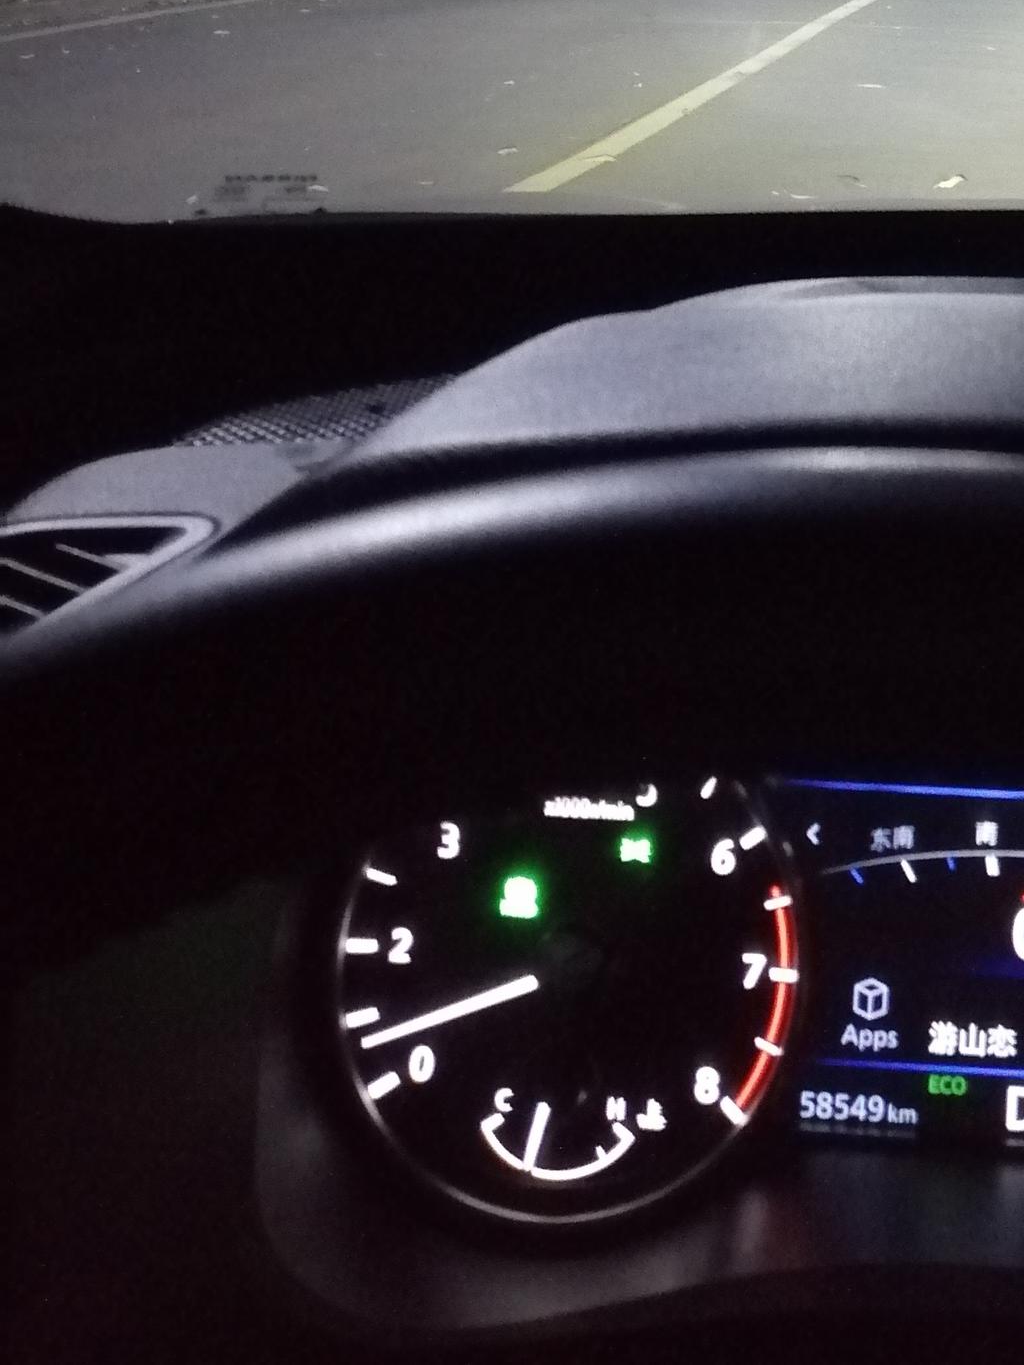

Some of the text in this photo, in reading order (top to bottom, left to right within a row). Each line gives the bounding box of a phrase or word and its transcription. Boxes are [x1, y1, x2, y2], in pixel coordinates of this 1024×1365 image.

[437, 821, 460, 859] 3
[711, 838, 736, 875] 6
[388, 927, 414, 964] 2
[742, 952, 768, 989] 7
[841, 1023, 898, 1052] Apps
[408, 1044, 435, 1083] 0
[694, 1066, 721, 1108] 8
[928, 1075, 968, 1095] ECO
